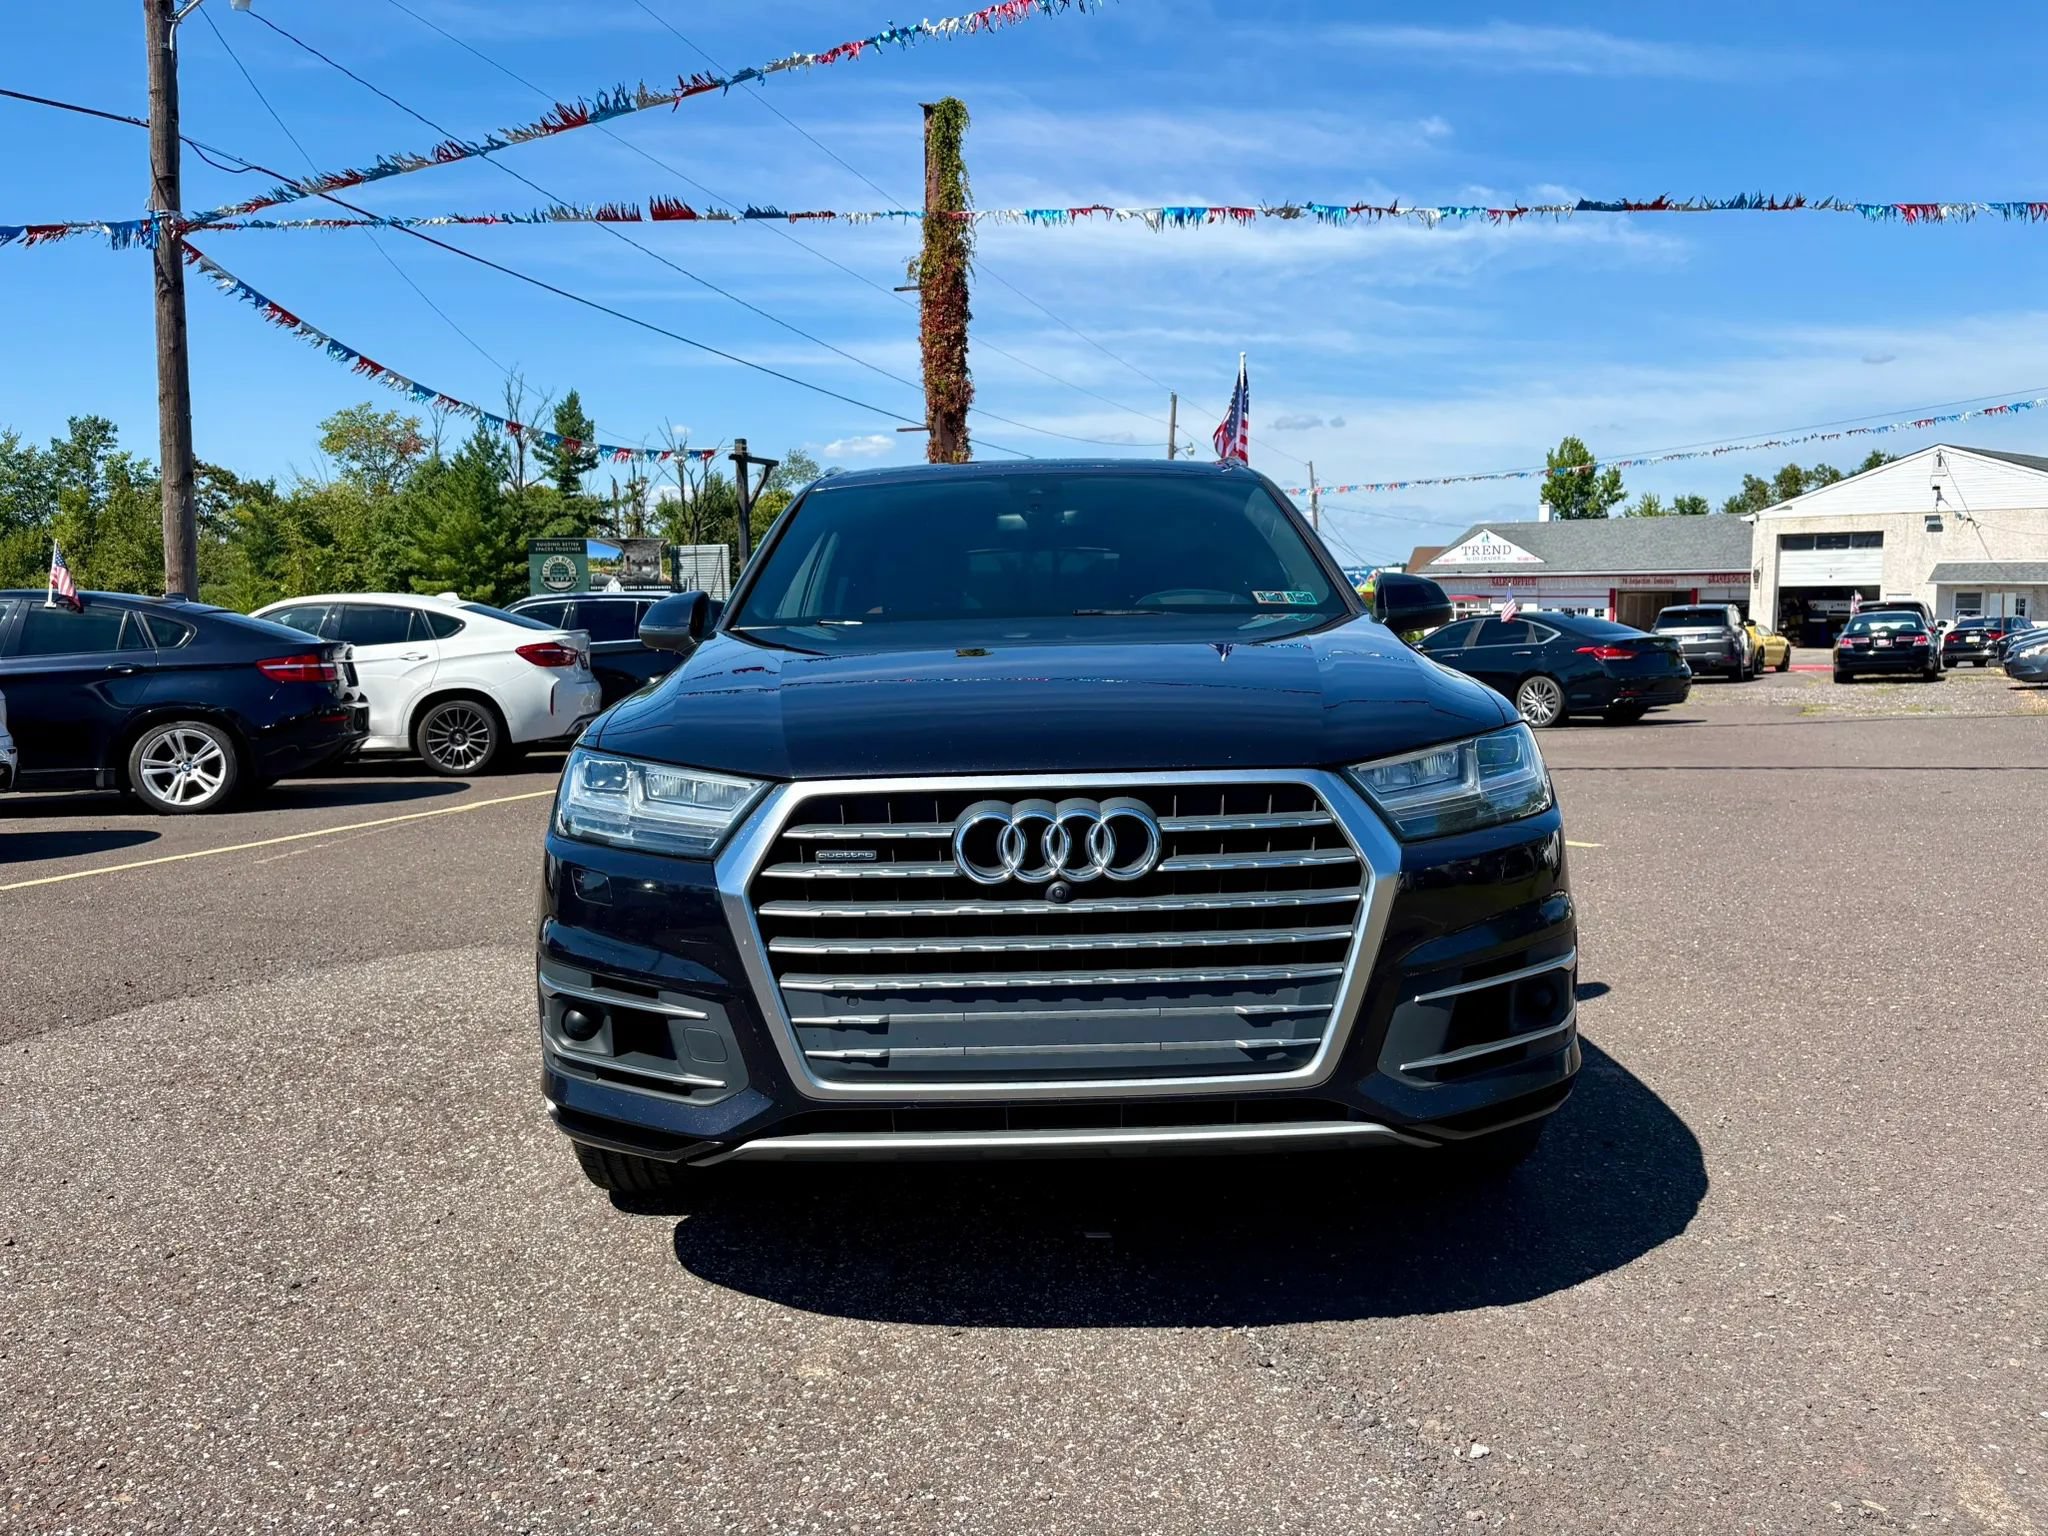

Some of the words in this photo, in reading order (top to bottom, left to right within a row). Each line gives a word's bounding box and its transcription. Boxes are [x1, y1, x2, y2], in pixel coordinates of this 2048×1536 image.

[1461, 544, 1512, 556] TREND
[1512, 576, 1536, 586] OFFICE
[818, 851, 875, 859] quattro
